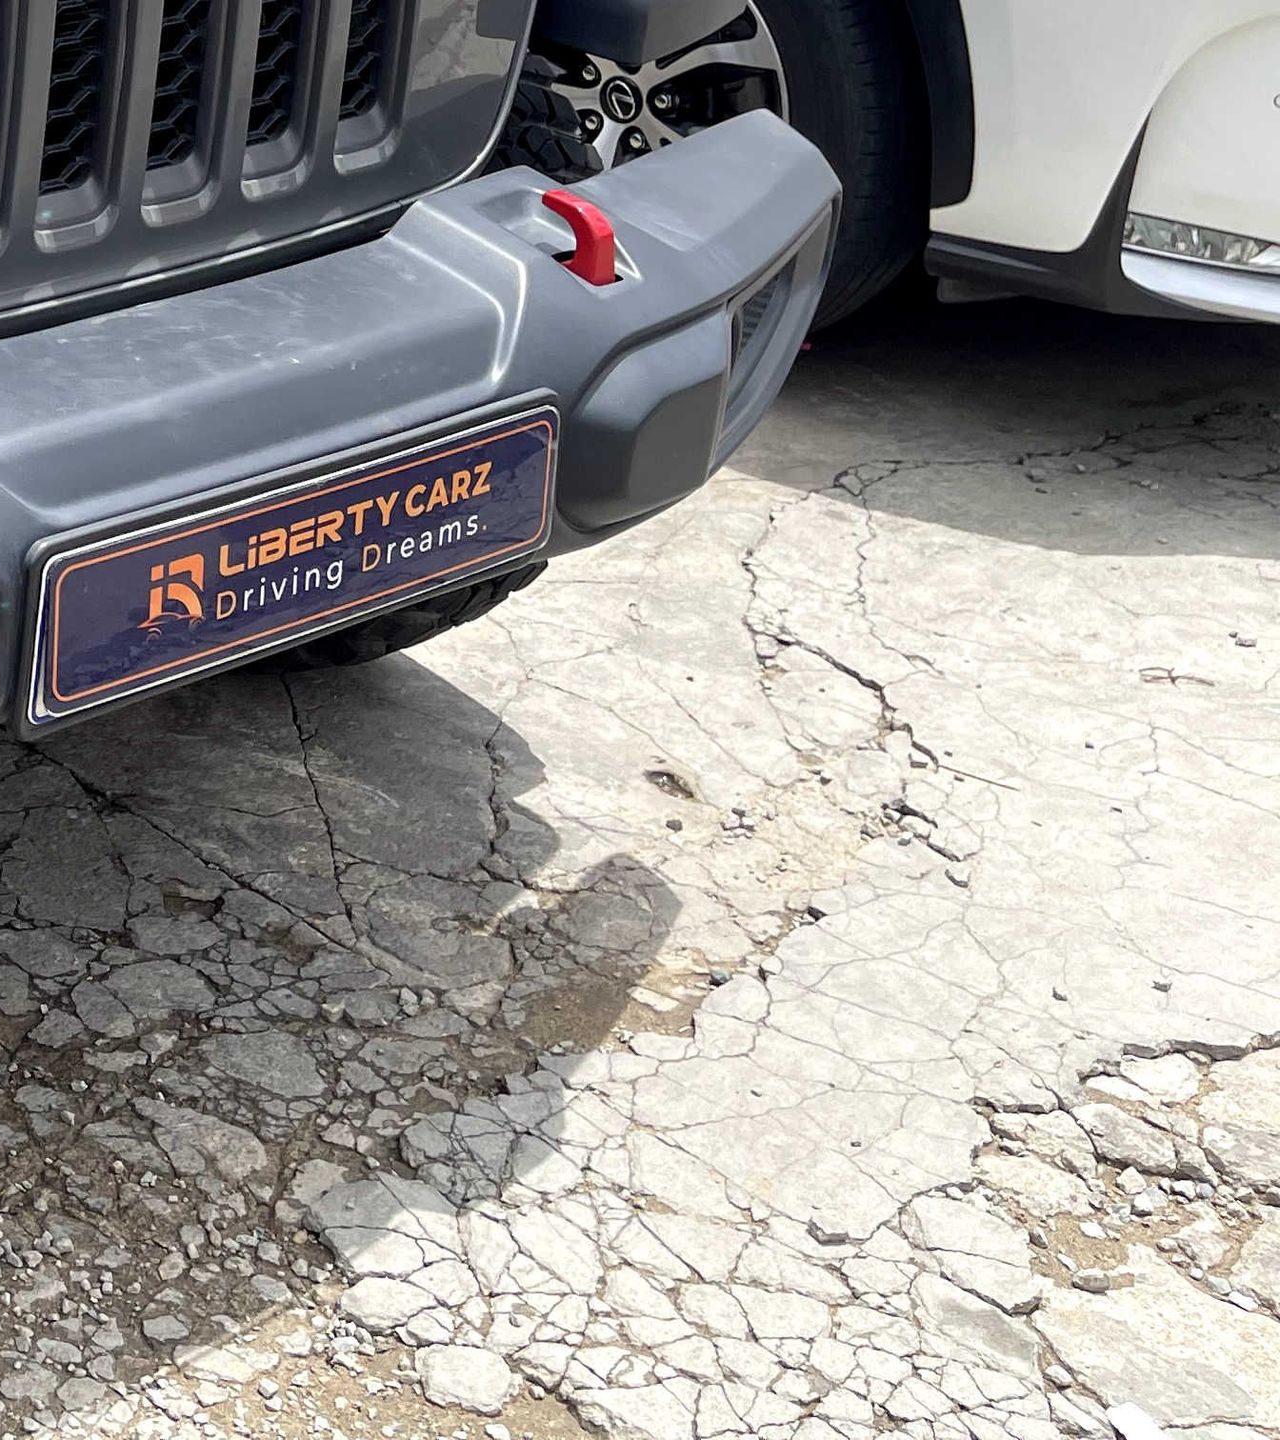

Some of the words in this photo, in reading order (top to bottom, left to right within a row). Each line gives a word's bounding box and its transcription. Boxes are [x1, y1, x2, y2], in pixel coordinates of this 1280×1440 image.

[403, 461, 494, 520] CARZ
[215, 557, 344, 621] Driving
[361, 510, 489, 574] Dreams.
